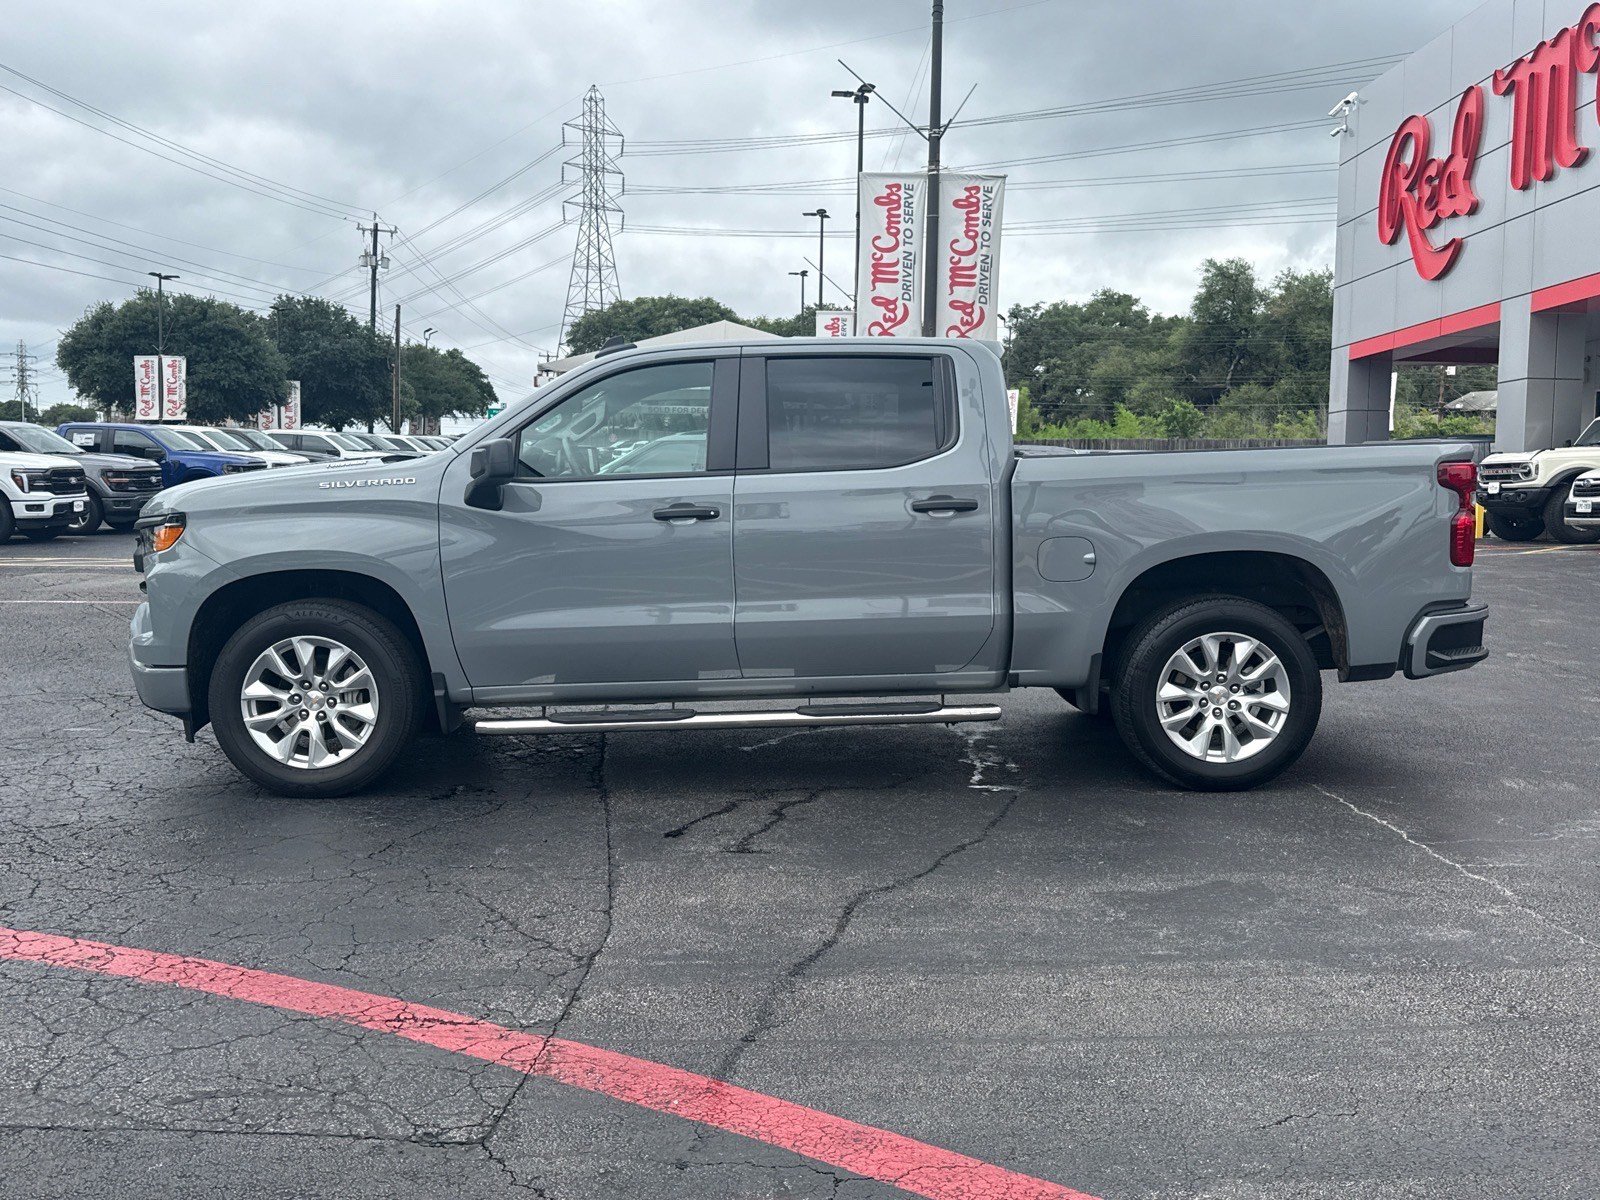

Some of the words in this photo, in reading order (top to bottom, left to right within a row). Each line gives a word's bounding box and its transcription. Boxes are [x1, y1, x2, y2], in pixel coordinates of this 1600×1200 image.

[1378, 85, 1486, 281] Red
[903, 182, 915, 225] SERVE
[981, 184, 993, 228] SERVE
[870, 182, 902, 292] McCombs
[902, 227, 914, 247] TO
[948, 184, 981, 296] McCombs
[980, 230, 992, 250] TO
[901, 250, 914, 302] DRIVEN
[977, 253, 990, 306] DRIVEN
[868, 295, 909, 336] Red
[945, 299, 985, 338] Red
[139, 359, 151, 398] McCombs
[166, 359, 178, 399] McCombs
[139, 399, 155, 417] Red
[166, 399, 182, 417] Red
[261, 414, 274, 429] Red
[284, 414, 297, 430] Red
[319, 477, 416, 489] SILVERADO
[294, 610, 339, 622] ALENZA
